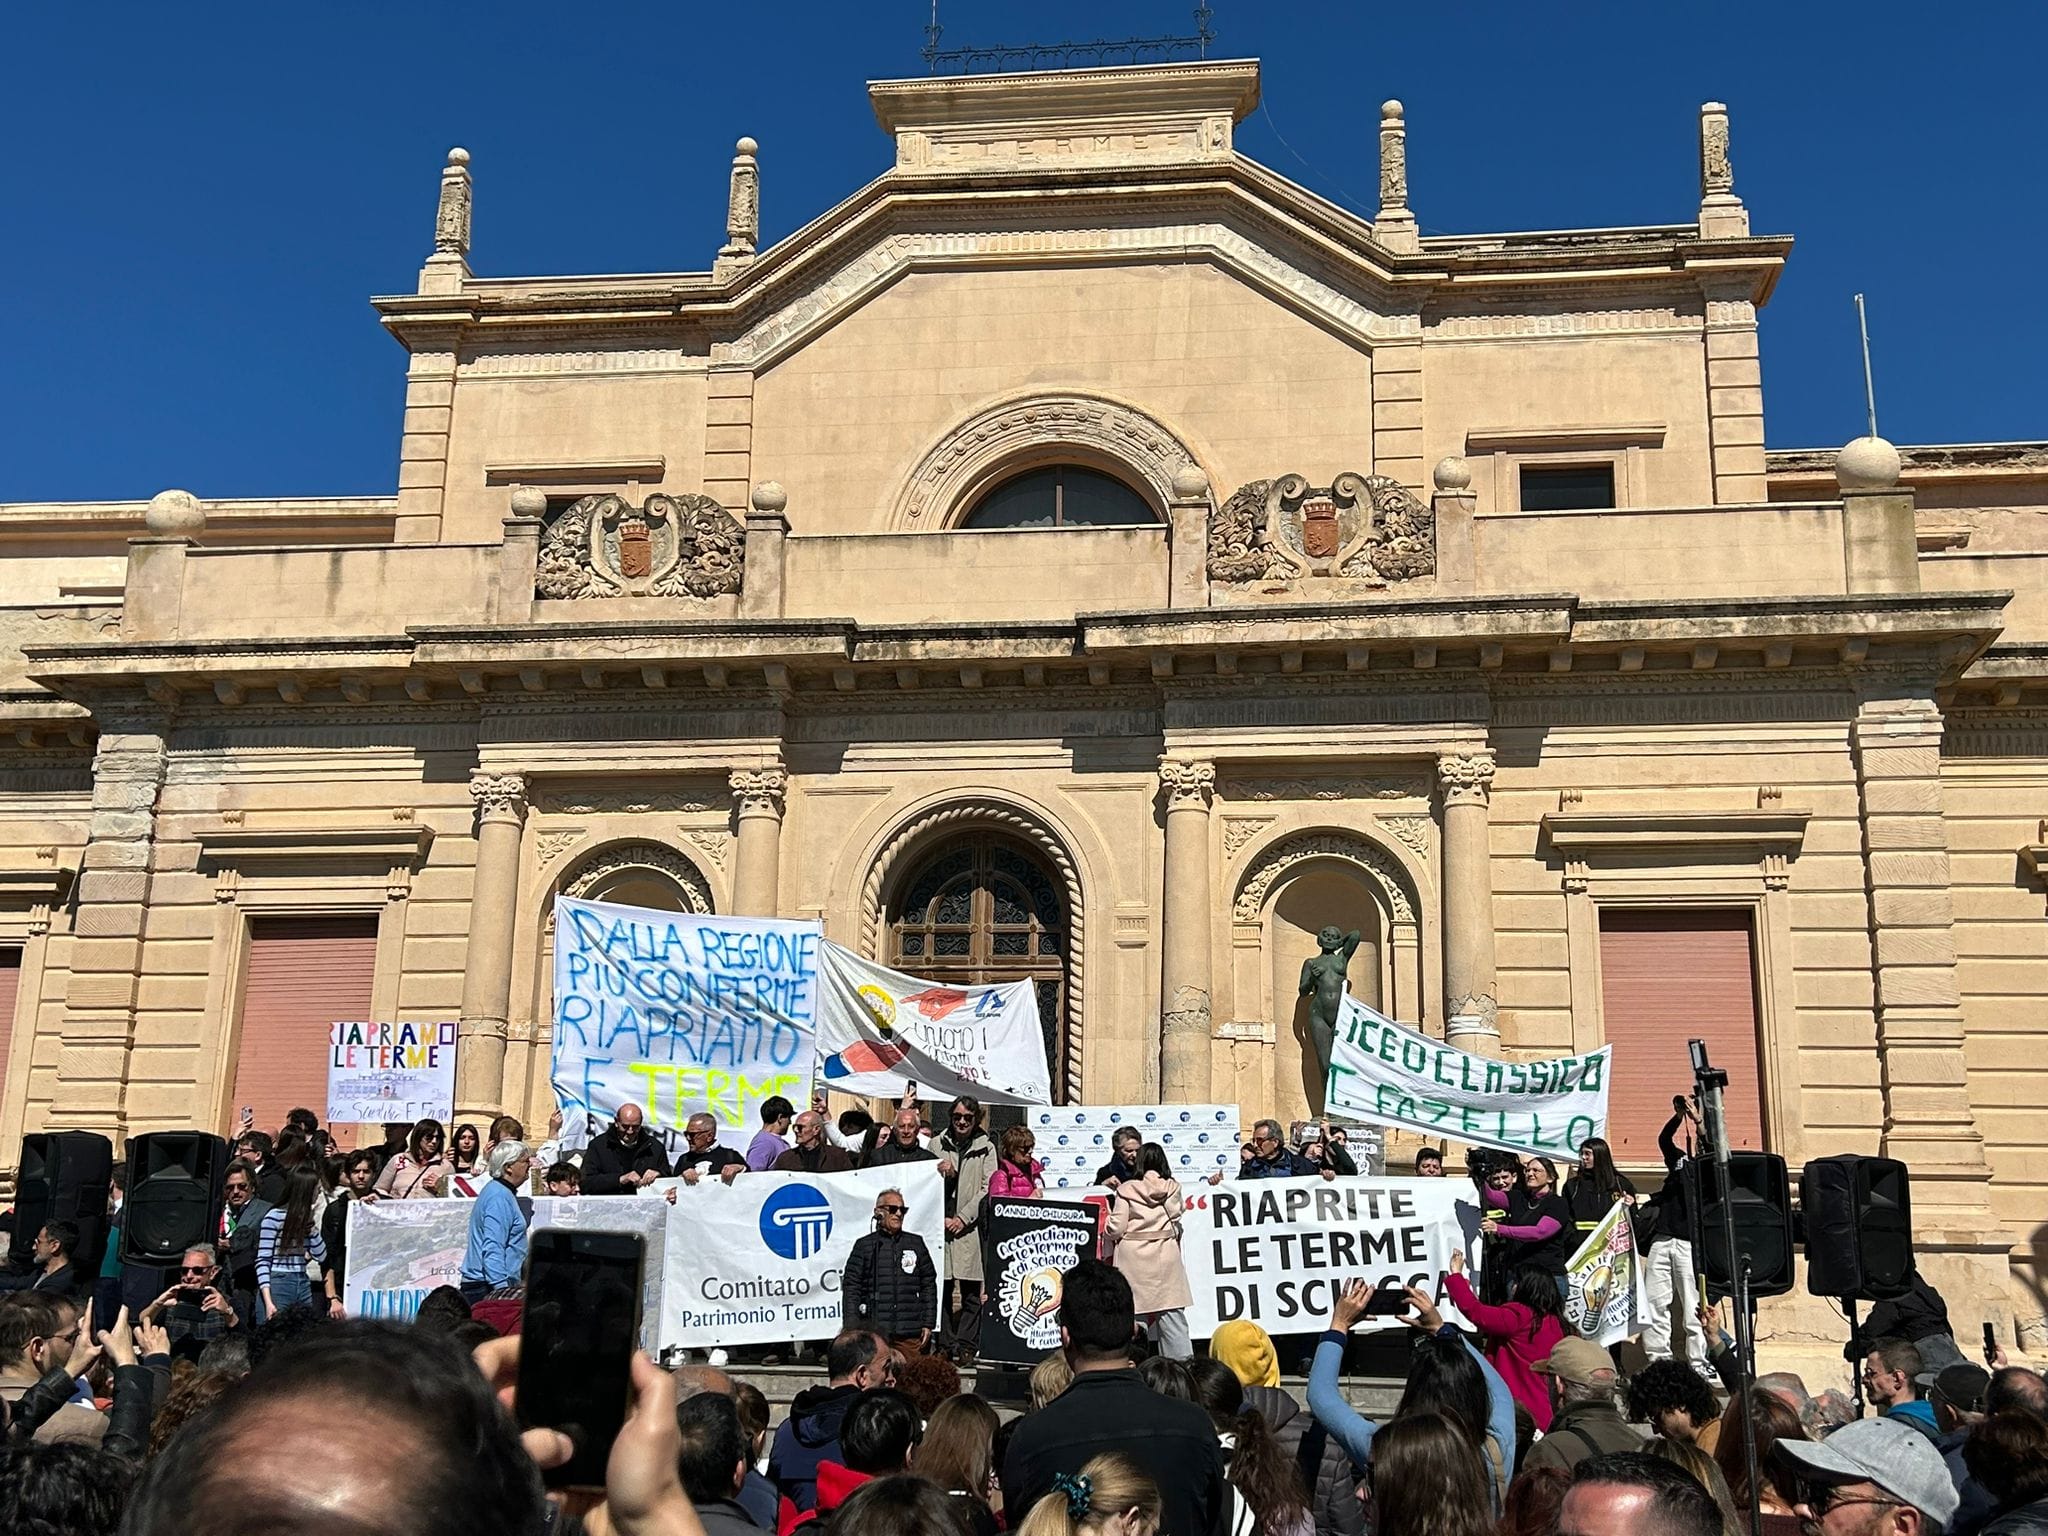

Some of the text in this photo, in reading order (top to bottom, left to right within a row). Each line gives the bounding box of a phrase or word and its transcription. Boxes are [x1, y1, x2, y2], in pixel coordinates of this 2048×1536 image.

[573, 909, 818, 976] DALLA REGIONE
[557, 995, 800, 1067] RIAPRIAMO
[333, 1045, 439, 1069] LE TERME
[995, 1206, 1002, 1216] 9
[1004, 1207, 1027, 1217] ANNI
[1030, 1208, 1039, 1217] DI
[1212, 1226, 1428, 1275] LE TERME
[700, 1269, 844, 1300] Comitato Ci
[1216, 1270, 1456, 1322] DI SCIA
[682, 1301, 842, 1328] Patrimonio Termal
